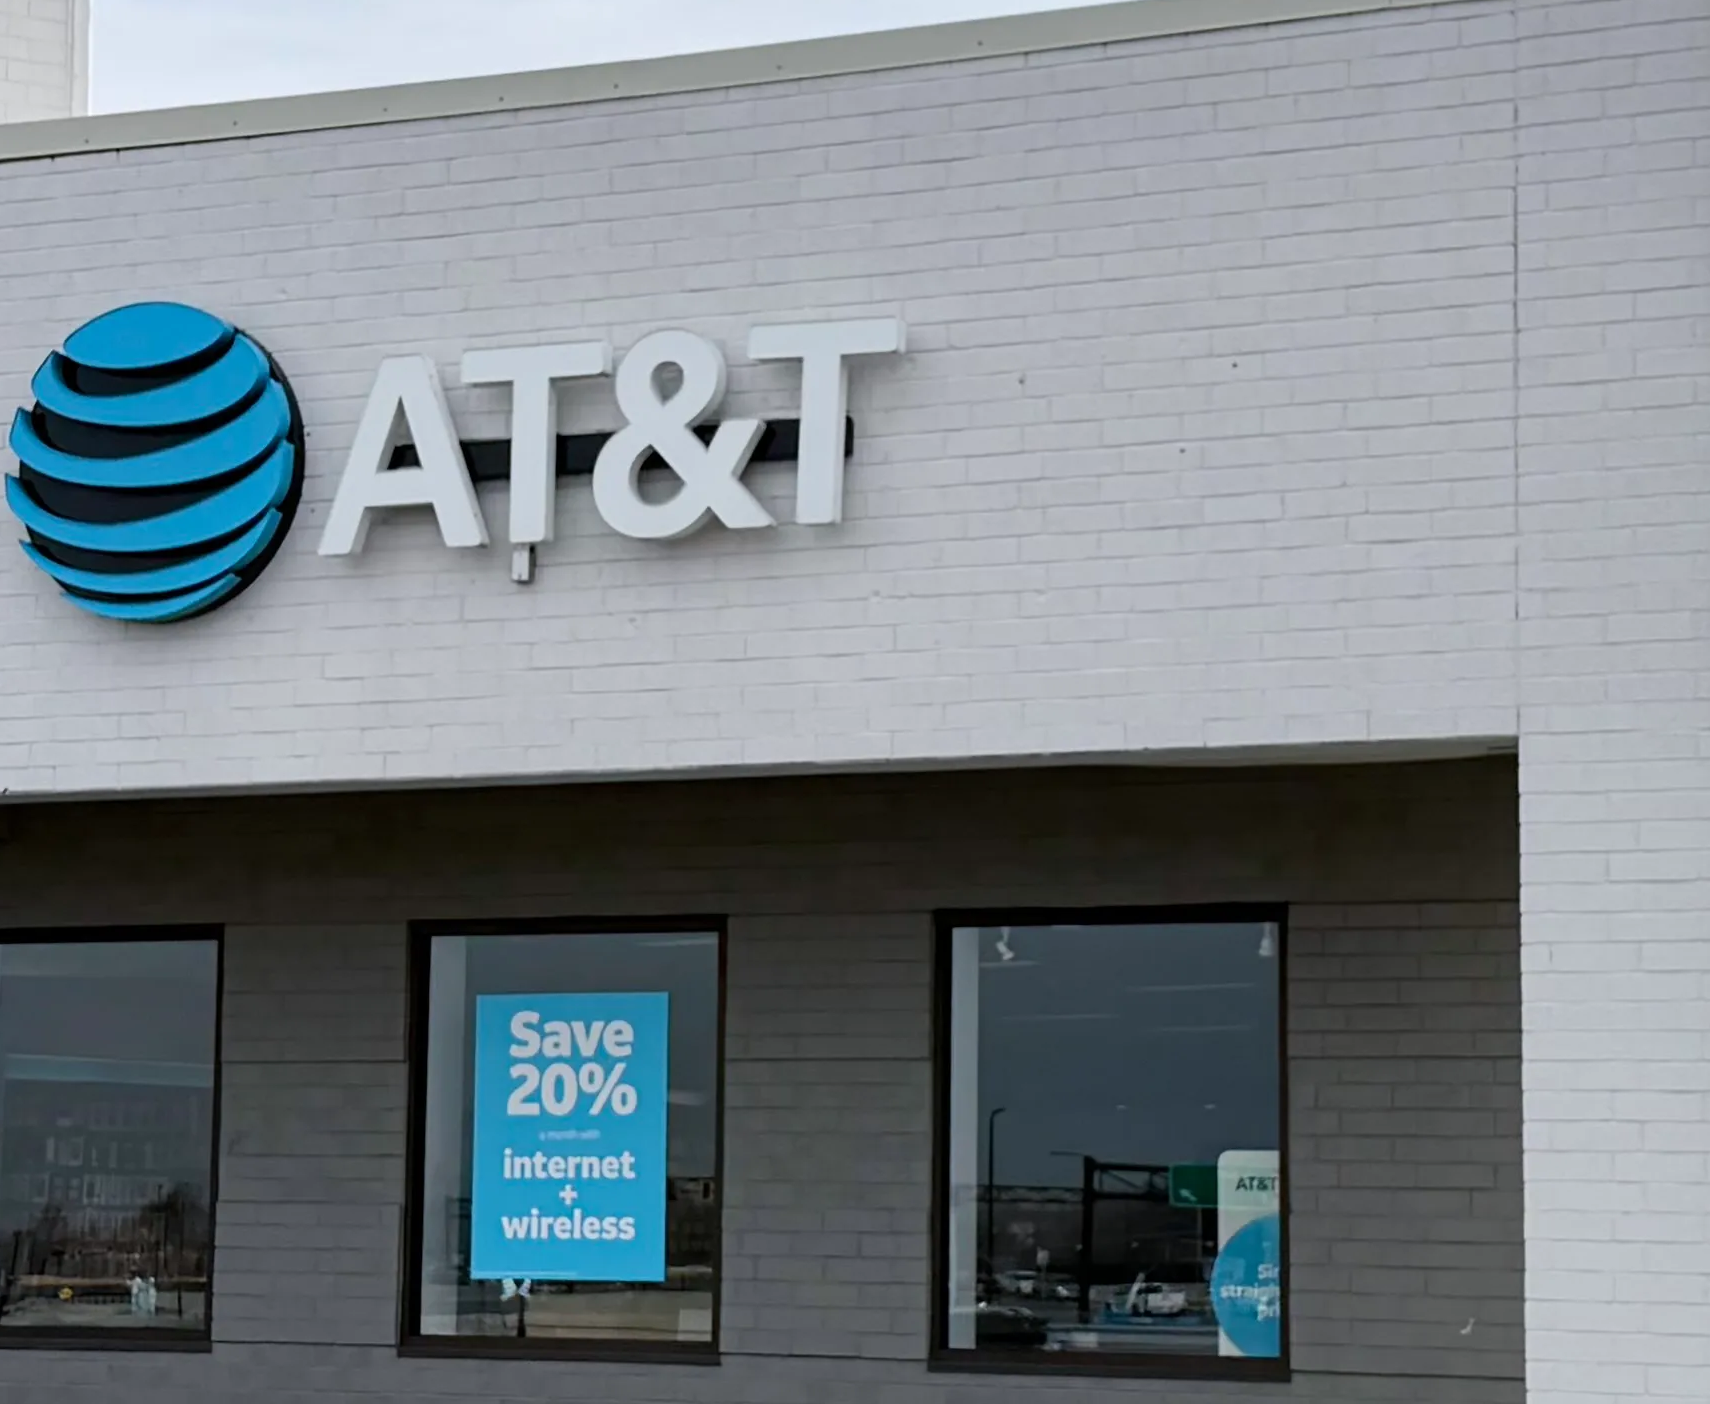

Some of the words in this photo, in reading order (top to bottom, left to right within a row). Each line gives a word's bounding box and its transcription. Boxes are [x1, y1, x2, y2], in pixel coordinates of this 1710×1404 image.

[318, 318, 907, 556] AT&T
[509, 1010, 634, 1058] Save
[506, 1062, 638, 1116] 20%
[503, 1147, 636, 1179] internet
[1235, 1176, 1279, 1192] AT&T
[501, 1208, 636, 1240] wireless
